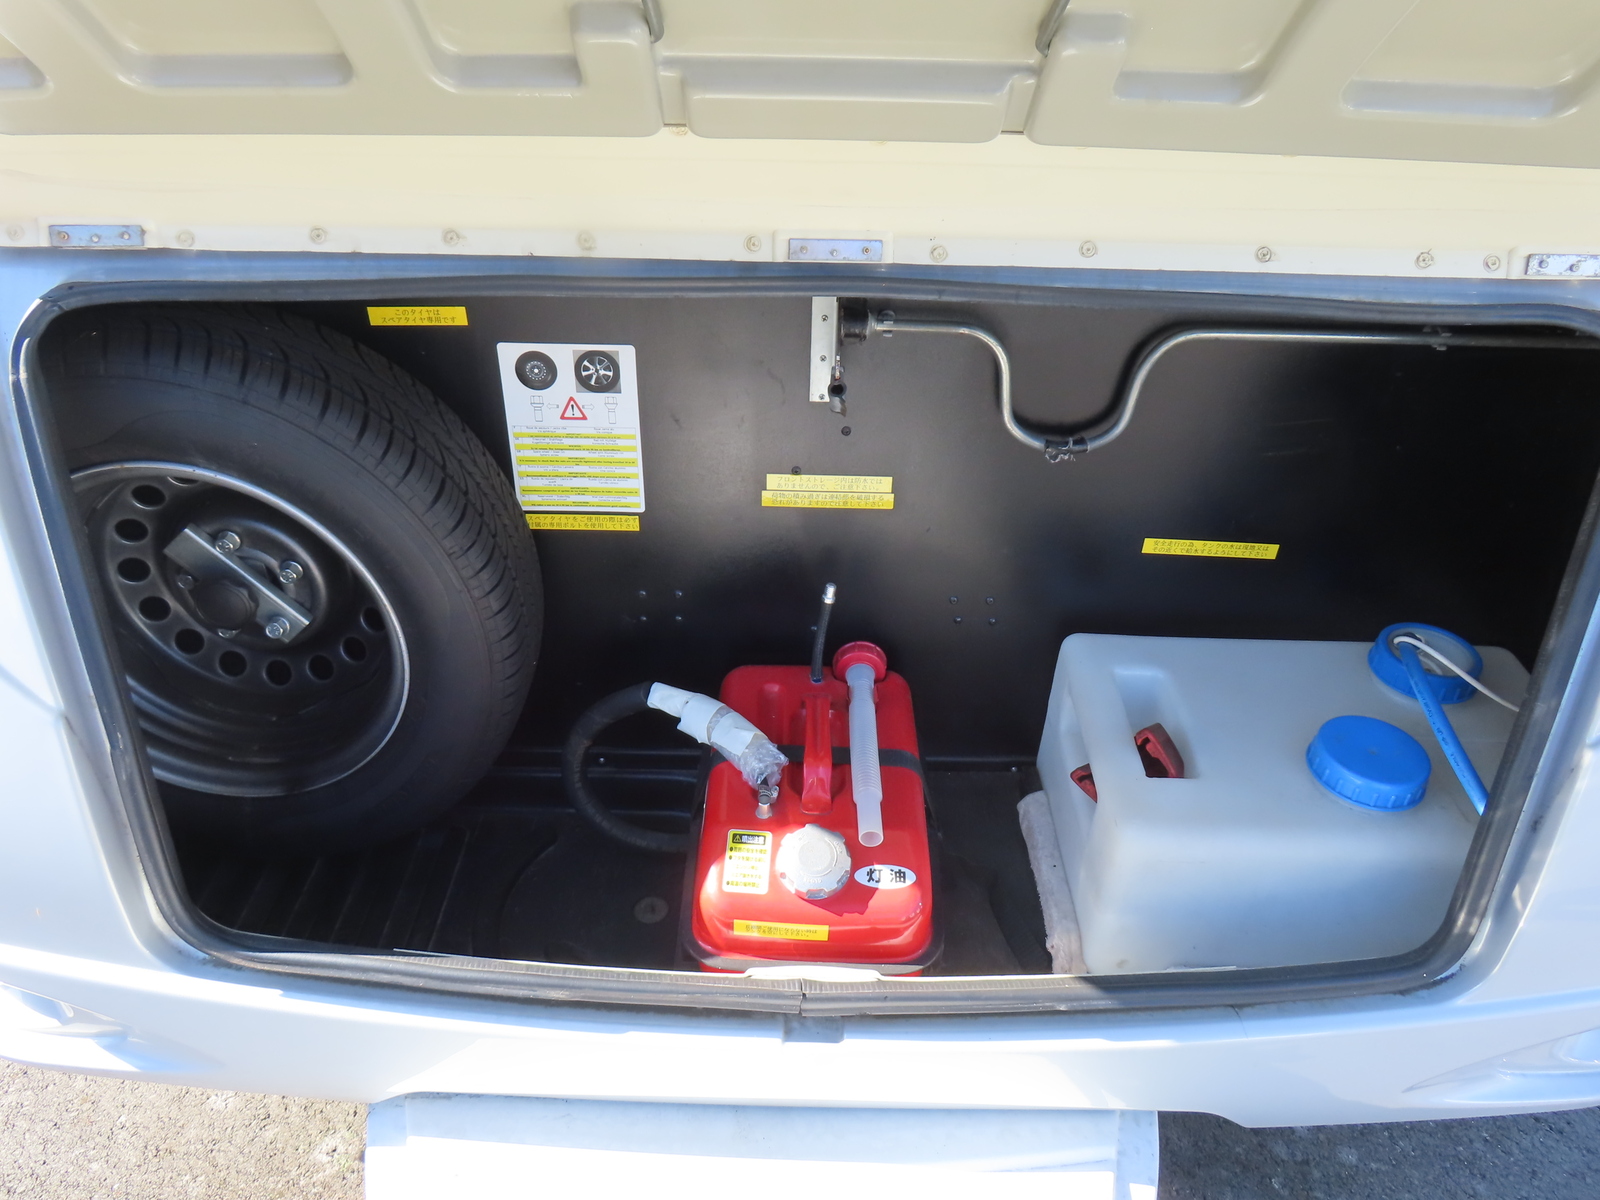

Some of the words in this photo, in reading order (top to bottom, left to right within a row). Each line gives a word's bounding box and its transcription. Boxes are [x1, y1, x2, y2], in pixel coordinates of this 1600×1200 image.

[381, 316, 456, 324] スペアタイヤ専用です
[866, 868, 907, 883] 灯油
